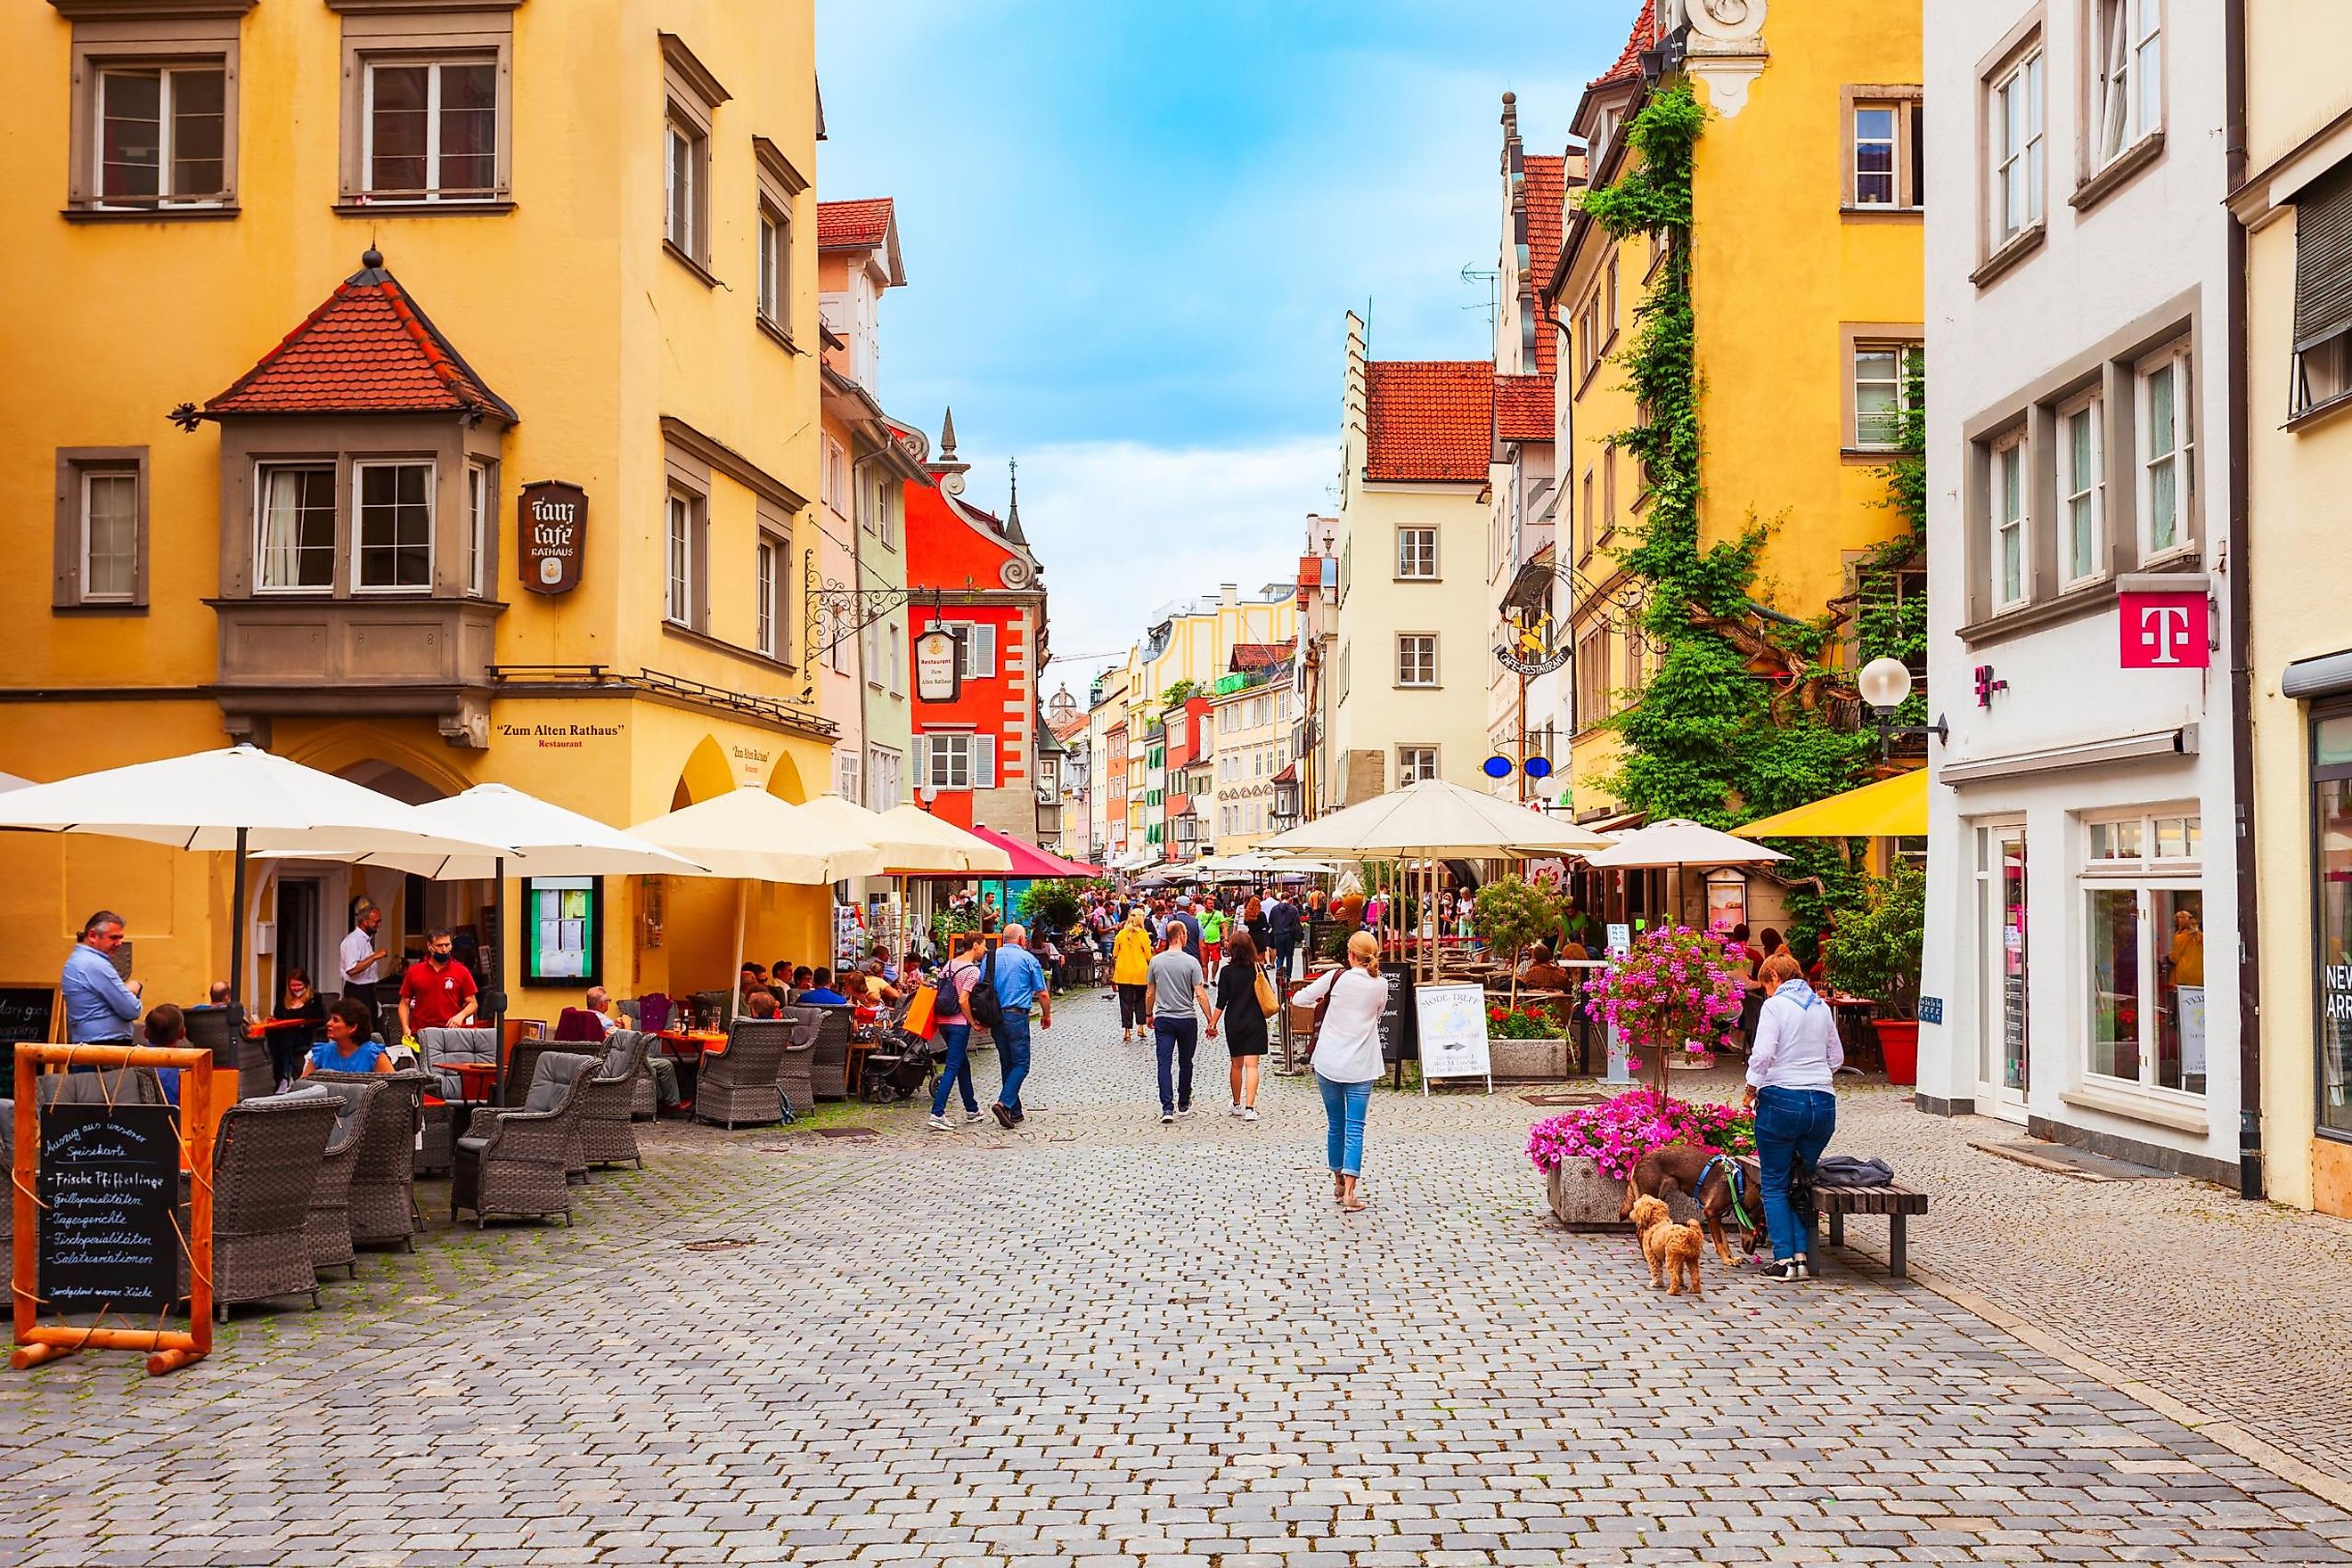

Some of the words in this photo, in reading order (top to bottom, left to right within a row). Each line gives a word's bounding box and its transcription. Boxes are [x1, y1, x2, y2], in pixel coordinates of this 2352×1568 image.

[531, 496, 575, 524] Tanz
[531, 547, 574, 557] RATHAUS
[2141, 607, 2189, 663] T
[1499, 652, 1566, 674] CAFE-RESTAURANT
[535, 724, 567, 736] Alten
[538, 739, 583, 747] Restaurant
[45, 1128, 81, 1156] Auszug
[82, 1123, 101, 1132] aus
[107, 1123, 147, 1143] unserer
[67, 1143, 127, 1162] Speisekarte
[94, 1171, 164, 1189] Pfifferlinge
[124, 1286, 153, 1298] Küche
